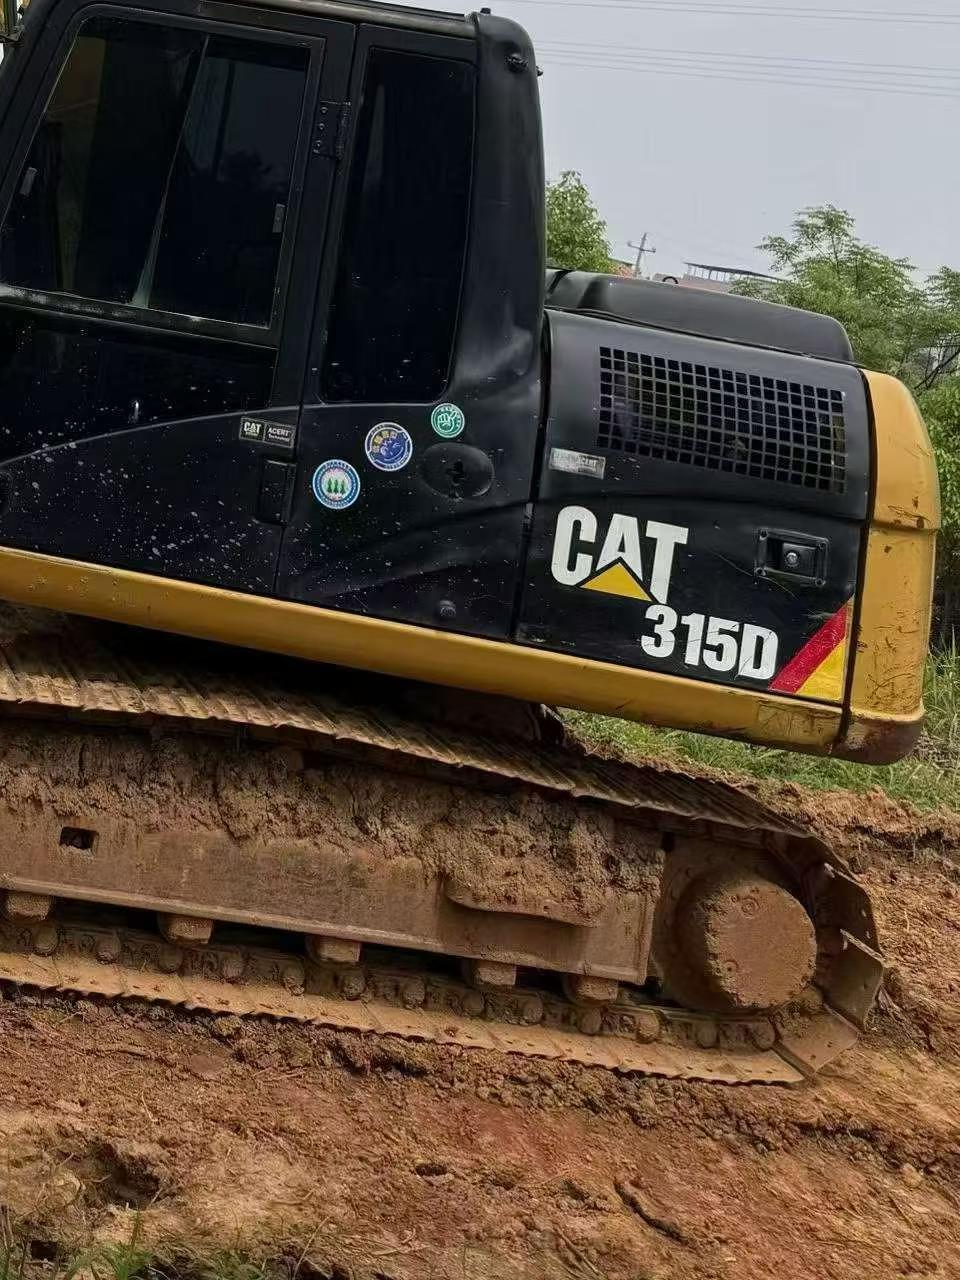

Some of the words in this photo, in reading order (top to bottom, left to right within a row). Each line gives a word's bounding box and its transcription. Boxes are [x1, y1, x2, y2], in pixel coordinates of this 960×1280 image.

[243, 421, 262, 434] CAT
[551, 505, 689, 605] CAT
[640, 604, 779, 680] 315D
